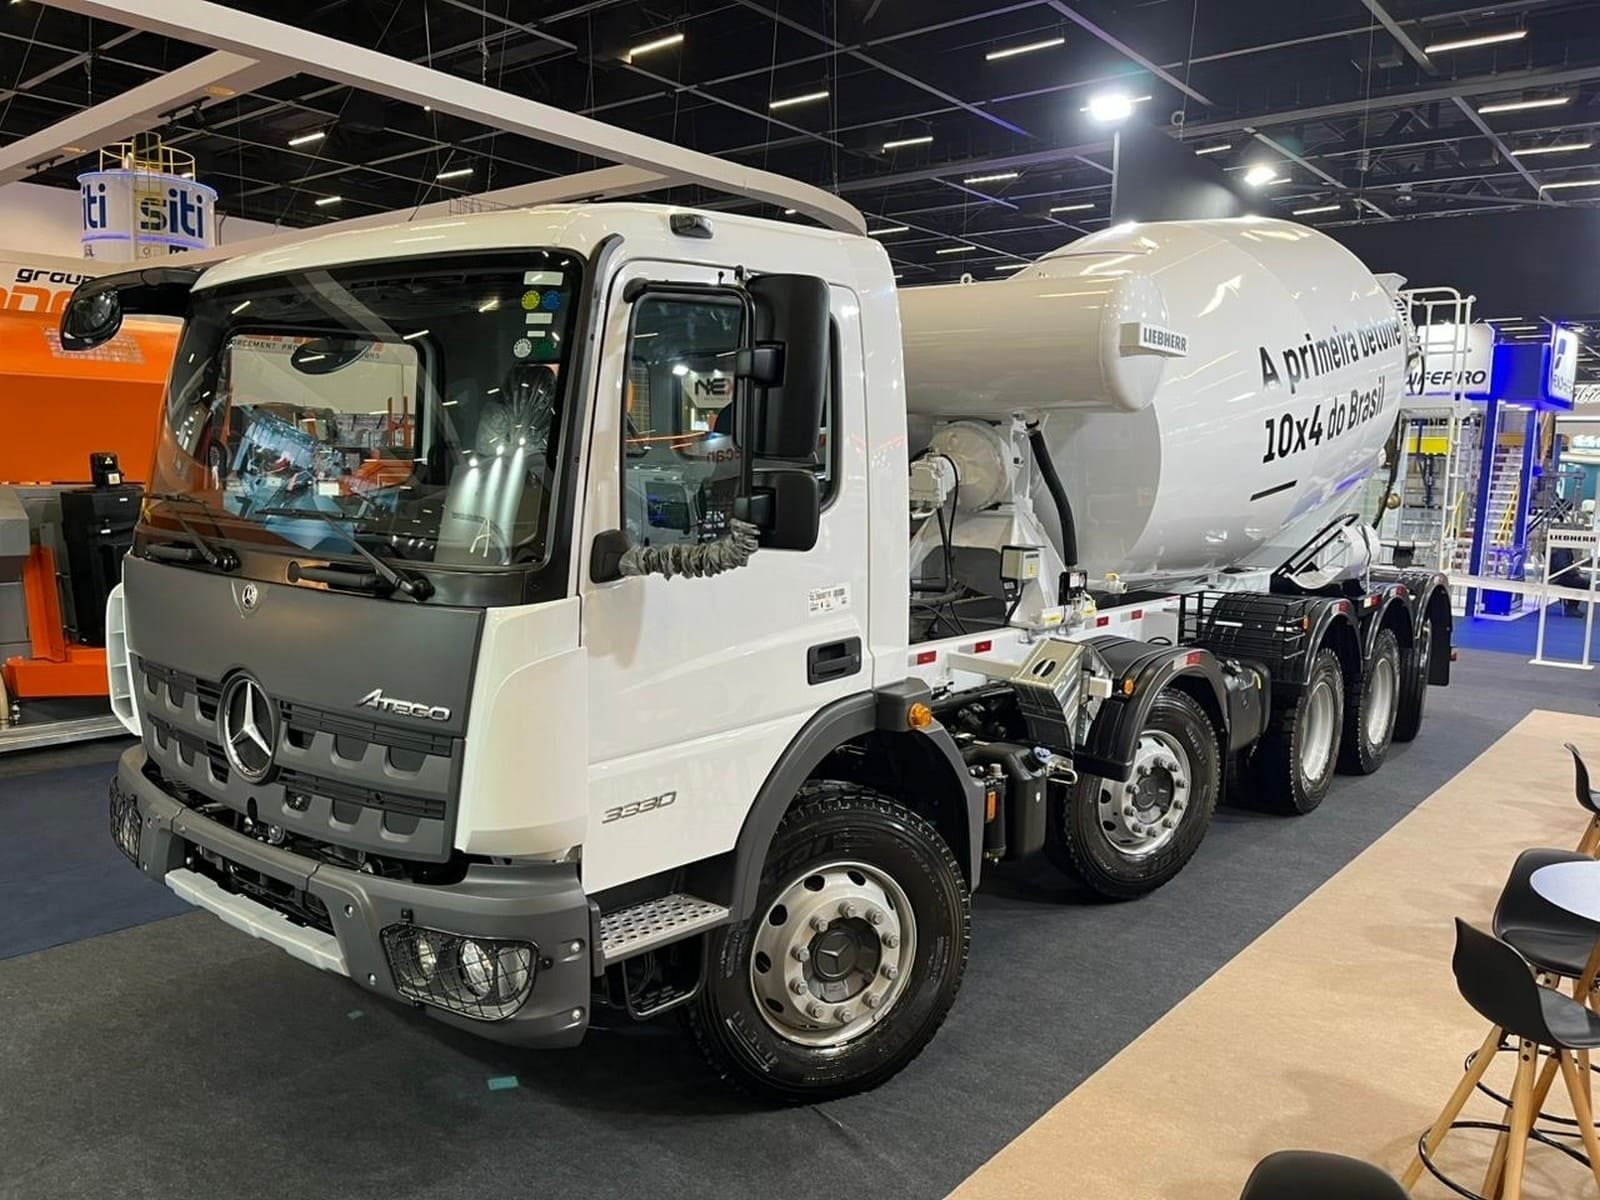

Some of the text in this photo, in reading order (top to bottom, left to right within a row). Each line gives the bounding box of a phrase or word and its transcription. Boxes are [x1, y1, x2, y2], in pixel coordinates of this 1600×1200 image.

[140, 188, 204, 239] siti
[1143, 327, 1187, 352] LIEBHERR
[1259, 346, 1281, 387] A
[1282, 325, 1360, 395] primeira
[1262, 374, 1386, 464] 10x4 do Brasil
[359, 688, 451, 721] ATEGO
[601, 791, 677, 824] 3330
